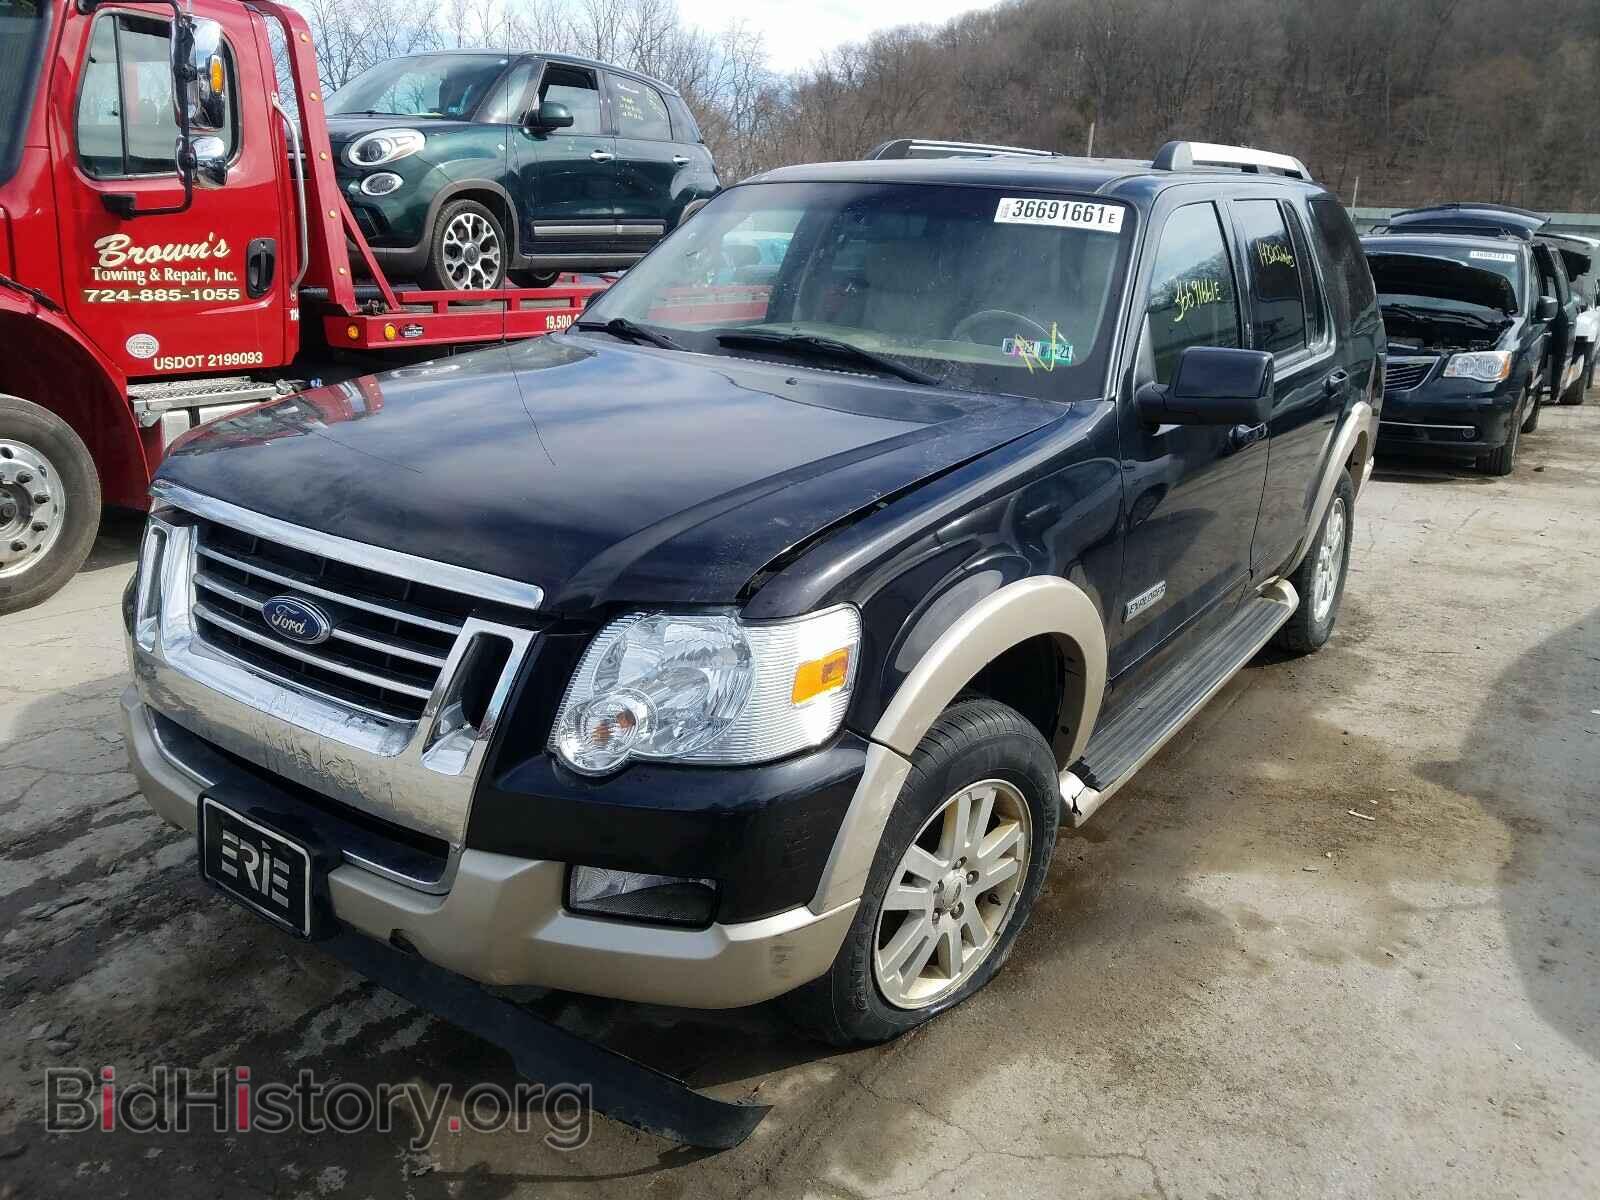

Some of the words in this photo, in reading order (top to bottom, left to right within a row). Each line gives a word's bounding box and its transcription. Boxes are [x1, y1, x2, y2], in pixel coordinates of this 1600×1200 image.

[94, 232, 231, 267] Brown's
[91, 267, 146, 285] Towing
[150, 268, 160, 281] &
[164, 267, 211, 285] Repair,
[214, 268, 238, 281] Inc.
[84, 288, 241, 302] 724-885-1055
[153, 355, 204, 370] USDOT
[207, 352, 263, 367] 2199093
[271, 604, 307, 635] Ford
[221, 829, 290, 909] ERIE
